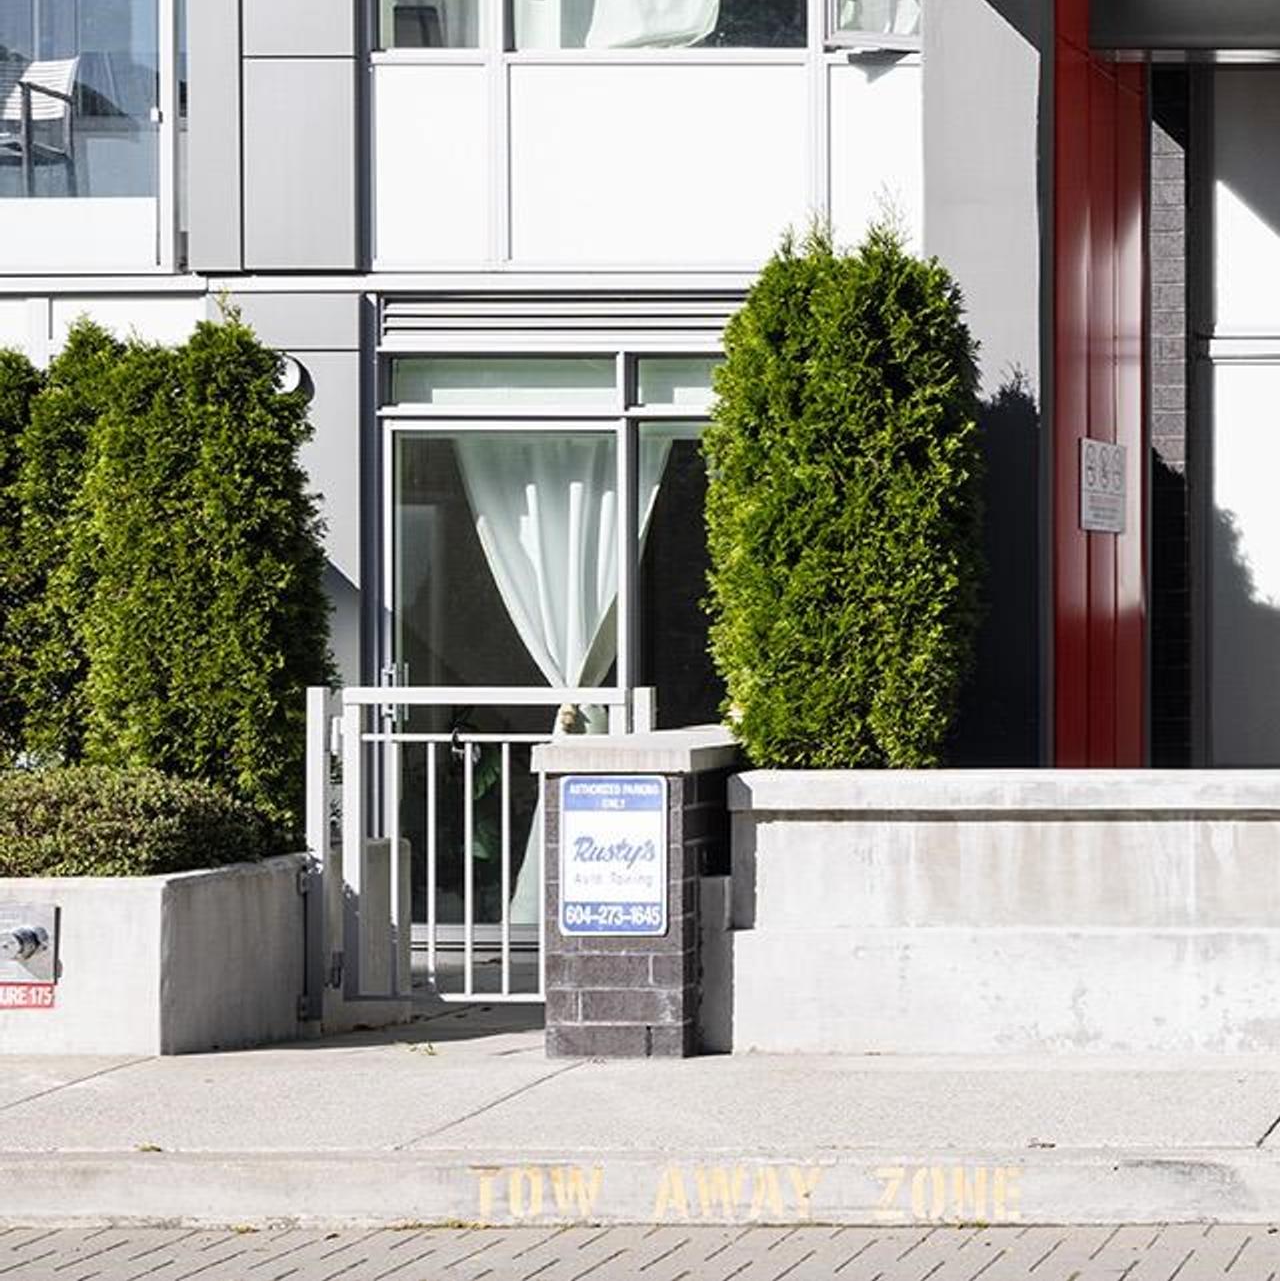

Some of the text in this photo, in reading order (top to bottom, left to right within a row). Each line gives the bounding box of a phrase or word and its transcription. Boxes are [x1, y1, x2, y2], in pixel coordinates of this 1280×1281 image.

[573, 835, 656, 869] Rusty's
[566, 904, 661, 926] 604-273-1645
[31, 985, 53, 1006] 175
[470, 1165, 1023, 1219] TOW AWAY ZONE
